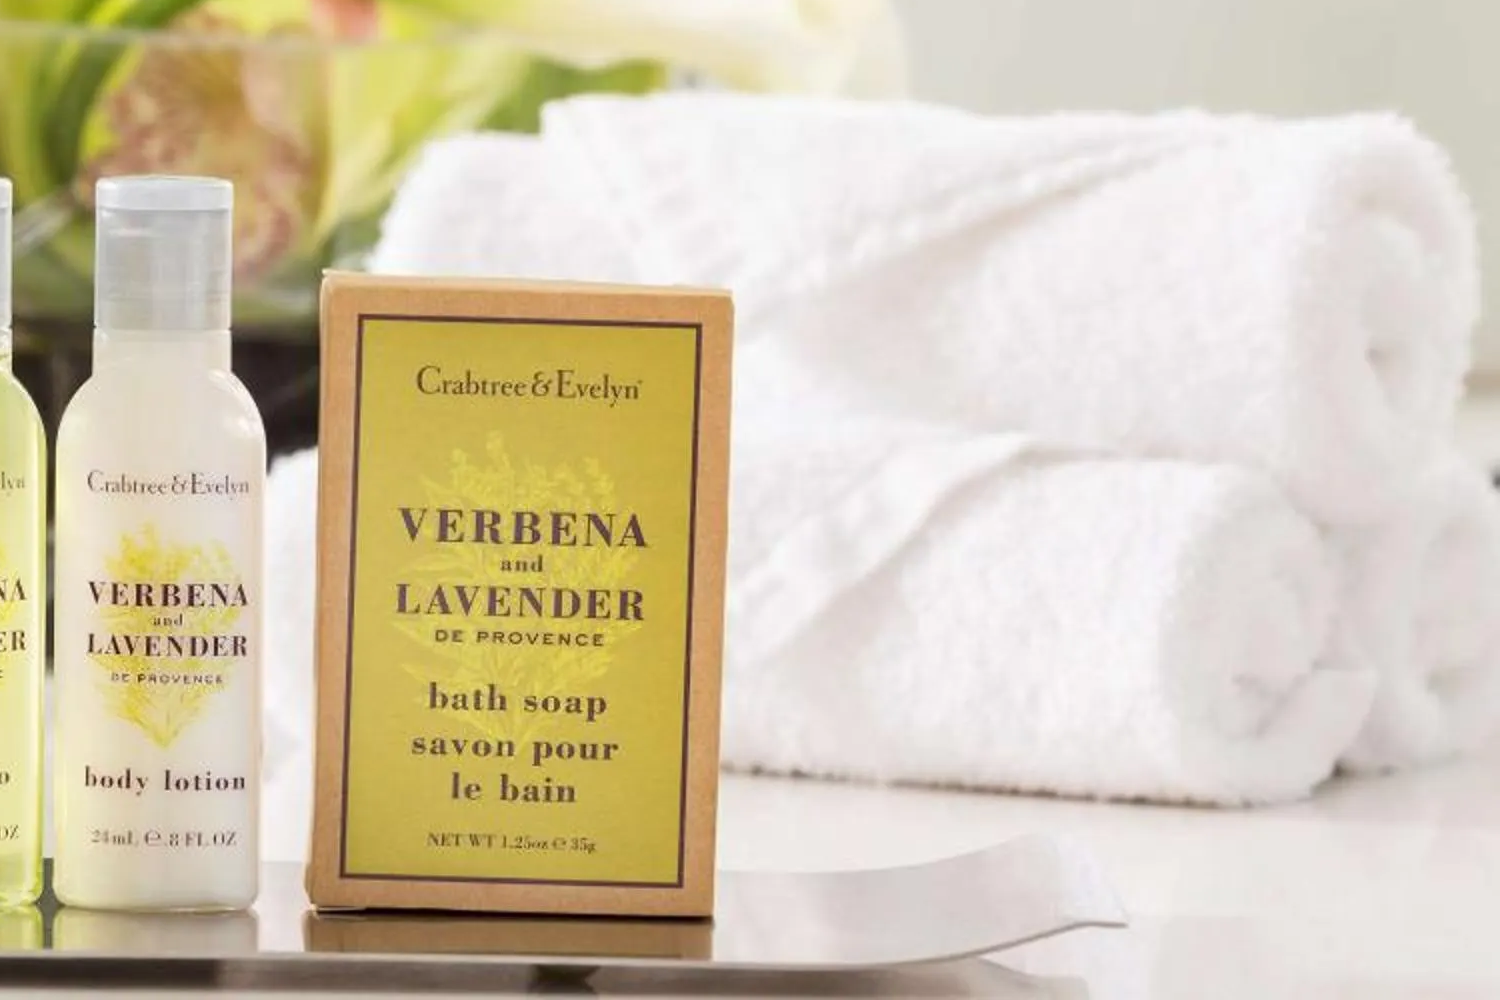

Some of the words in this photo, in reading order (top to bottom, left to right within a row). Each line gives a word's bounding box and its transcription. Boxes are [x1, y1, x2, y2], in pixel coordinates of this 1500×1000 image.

[531, 371, 551, 397] &
[171, 474, 186, 494] &
[398, 508, 648, 548] VERBENA
[501, 556, 543, 573] and
[87, 581, 248, 607] VERBENA
[396, 583, 645, 622] LAVENDER
[152, 615, 183, 627] and
[88, 633, 247, 657] LAVENDER
[435, 630, 463, 644] DE
[476, 632, 604, 647] PROVENCE
[111, 673, 130, 682] DE
[137, 674, 223, 684] PROVENCE
[428, 683, 507, 711] bath
[524, 694, 608, 721] soap
[412, 735, 515, 757] savon
[533, 741, 619, 765] pour
[85, 766, 148, 796] body
[164, 769, 246, 791] lotion
[451, 773, 482, 800] le
[501, 774, 576, 803] bain
[427, 832, 461, 847] NET
[468, 833, 497, 849] WT
